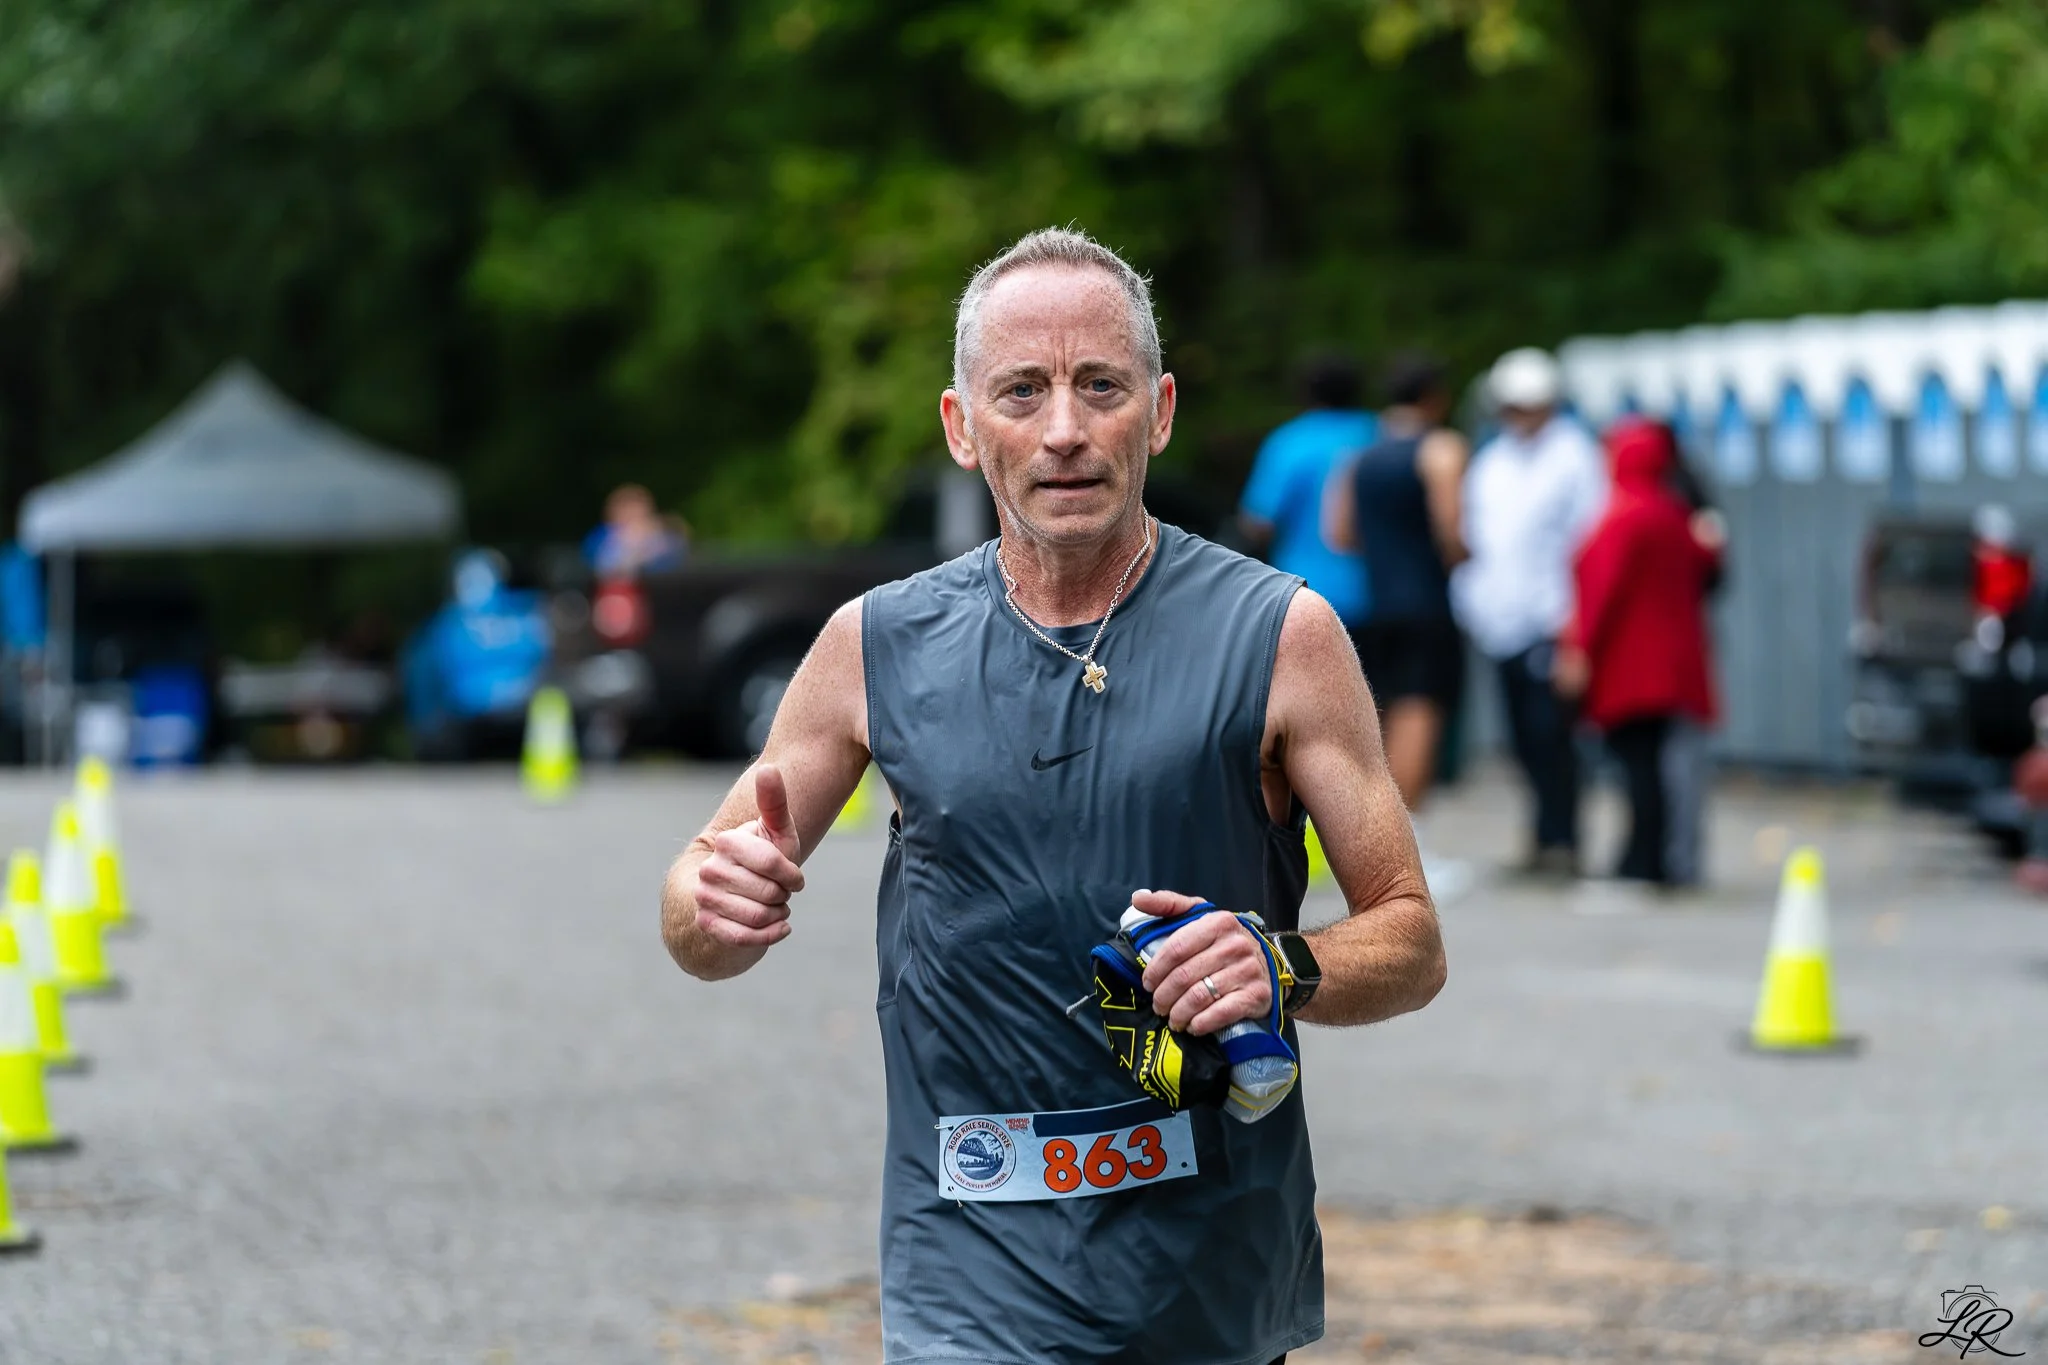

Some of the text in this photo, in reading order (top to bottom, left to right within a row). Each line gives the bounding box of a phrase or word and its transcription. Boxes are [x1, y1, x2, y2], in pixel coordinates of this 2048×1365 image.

[948, 1132, 963, 1151] ROAD
[960, 1121, 977, 1134] RACE
[977, 1121, 999, 1134] SERIES
[1043, 1124, 1168, 1193] 863
